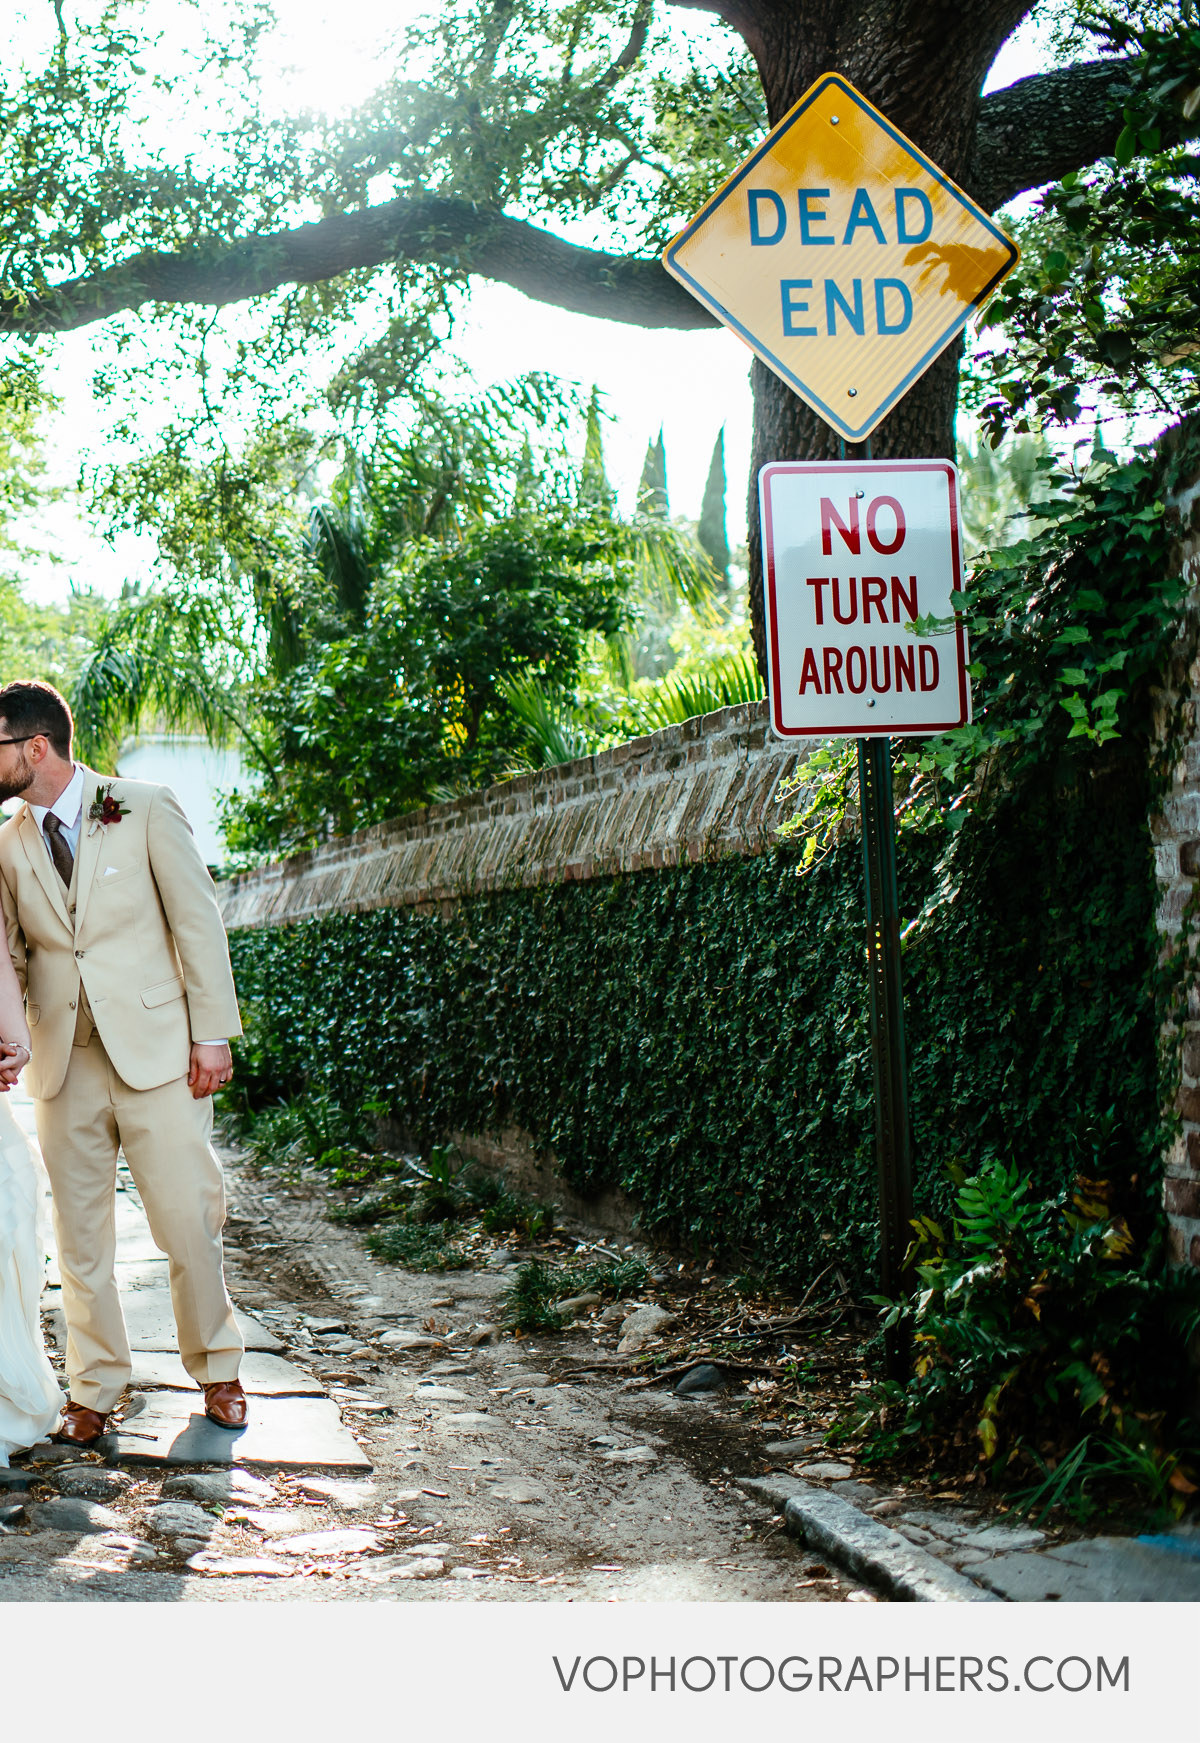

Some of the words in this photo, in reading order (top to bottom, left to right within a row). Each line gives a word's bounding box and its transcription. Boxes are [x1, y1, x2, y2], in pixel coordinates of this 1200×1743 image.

[747, 187, 934, 246] DEAD
[780, 277, 914, 337] END
[819, 495, 907, 556] NO
[806, 575, 919, 625] TURN
[798, 644, 940, 695] AROUND
